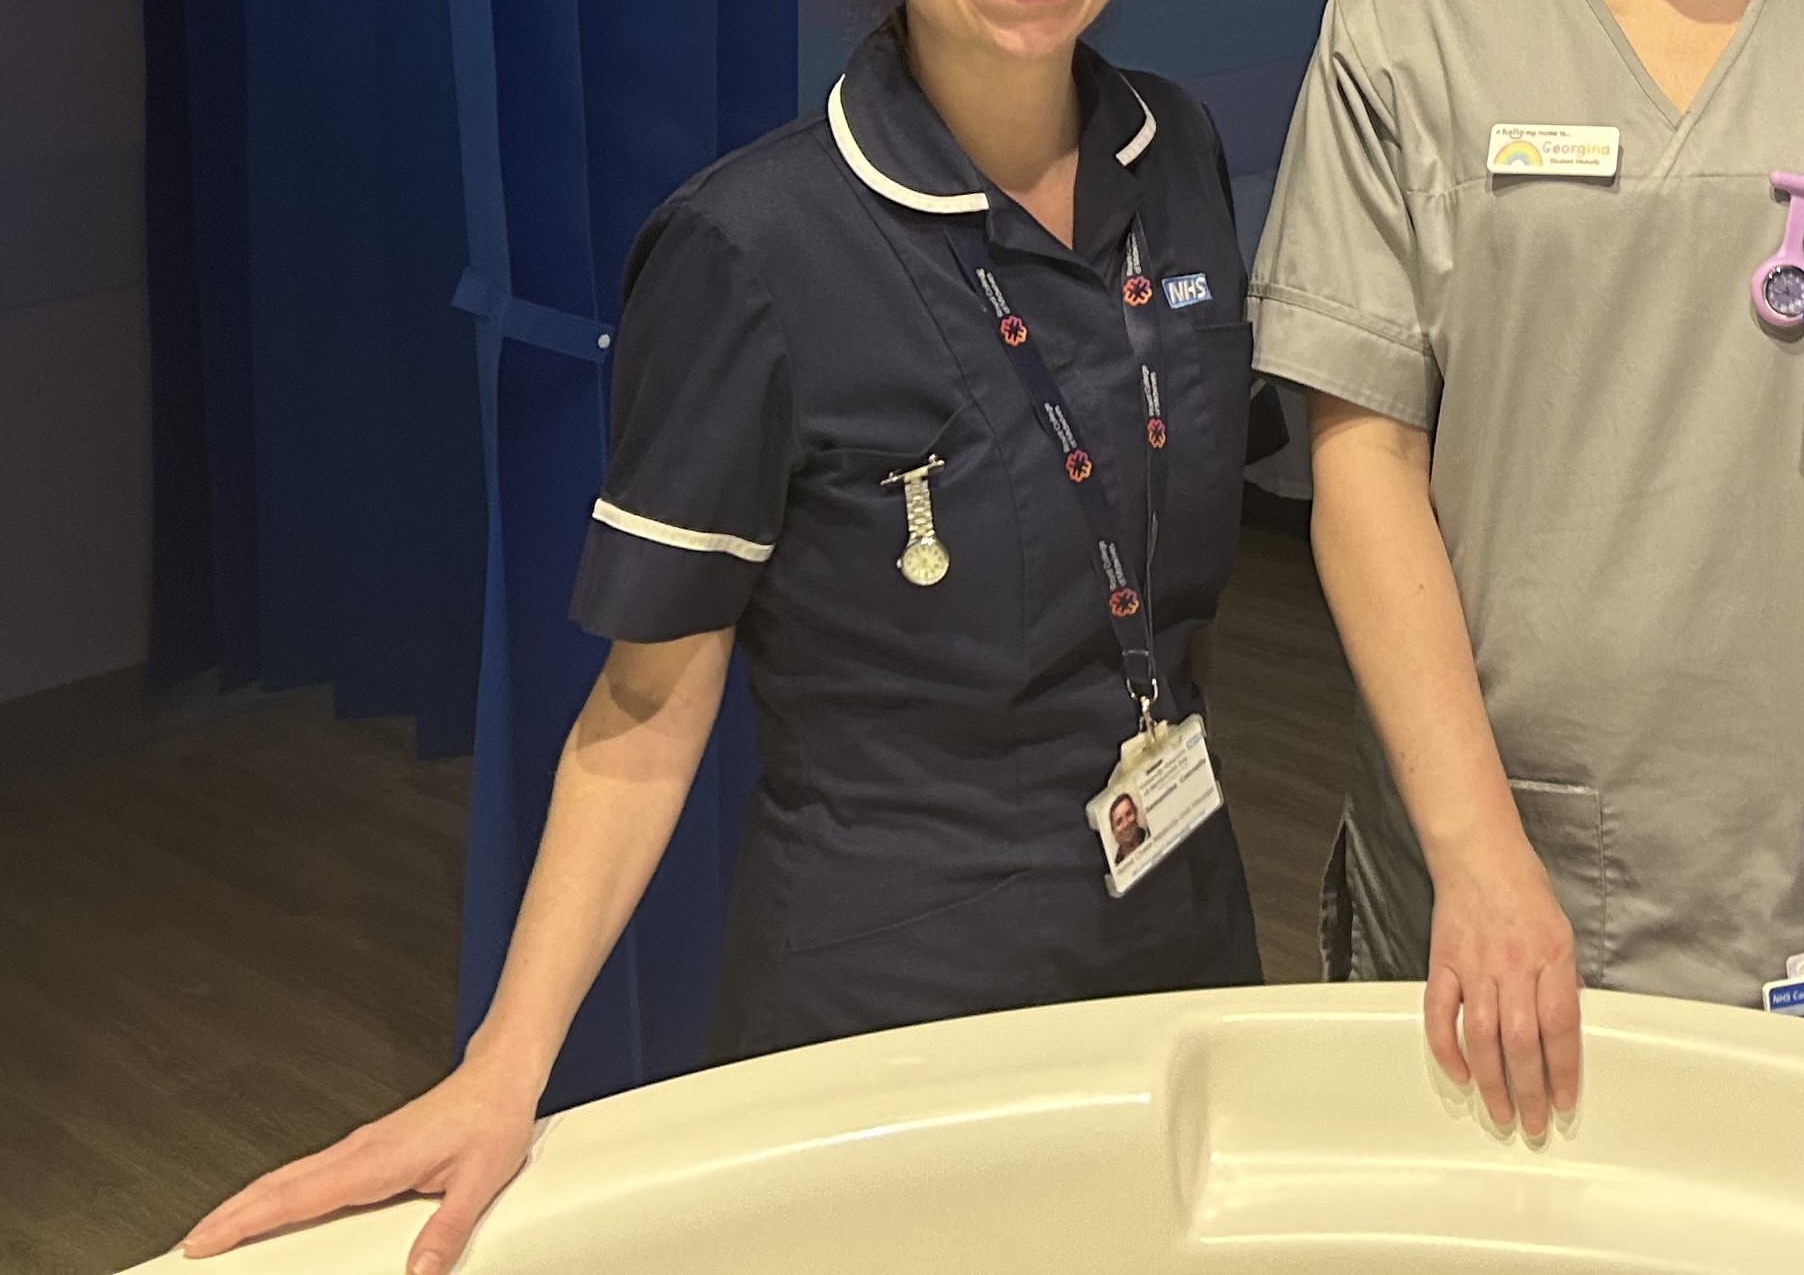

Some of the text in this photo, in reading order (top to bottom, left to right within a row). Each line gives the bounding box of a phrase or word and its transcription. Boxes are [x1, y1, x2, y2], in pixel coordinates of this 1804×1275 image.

[1525, 130, 1536, 138] my
[1542, 140, 1610, 158] Georgina
[1168, 276, 1206, 304] NHS
[1772, 992, 1791, 1004] NHS
